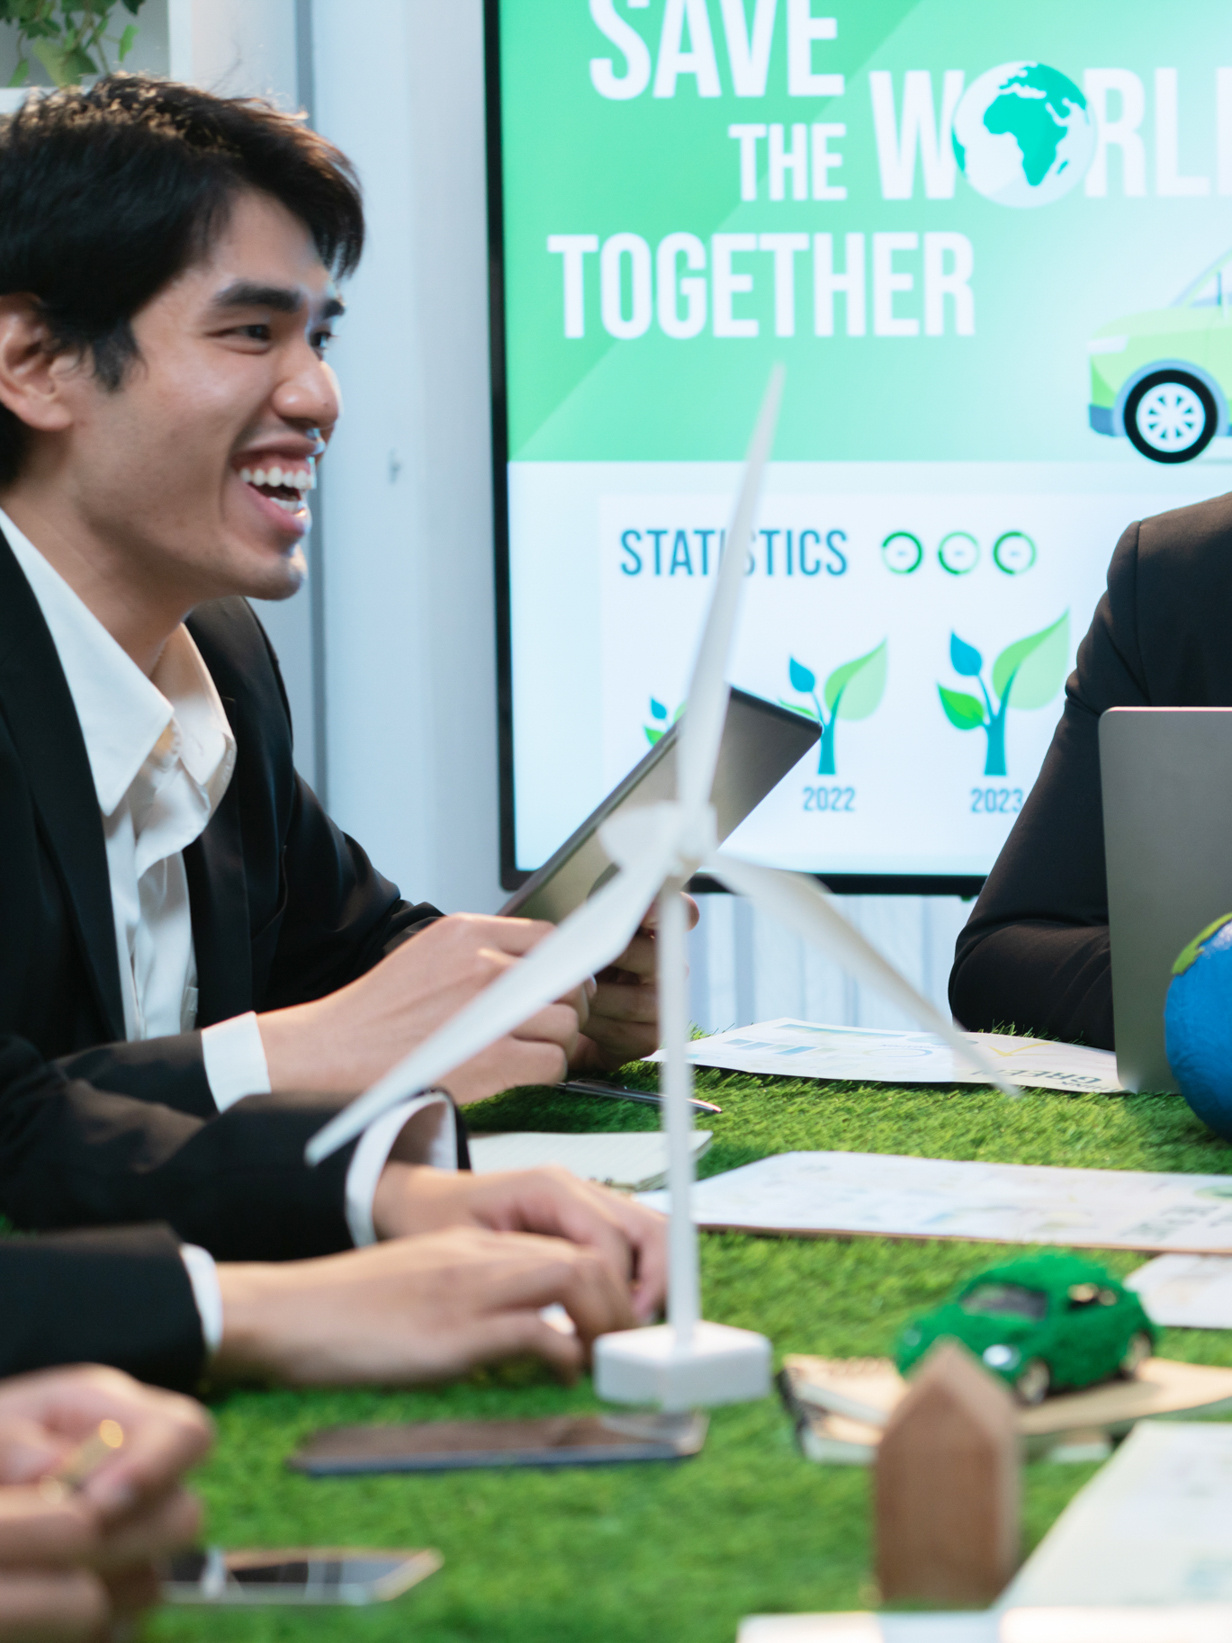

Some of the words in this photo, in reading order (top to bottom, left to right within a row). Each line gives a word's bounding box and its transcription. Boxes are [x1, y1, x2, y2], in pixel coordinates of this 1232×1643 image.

[589, 0, 845, 100] SAVE
[728, 122, 847, 201] THE
[547, 231, 976, 339] TOGETHER
[803, 786, 856, 812] 2022
[971, 788, 1024, 813] 2023
